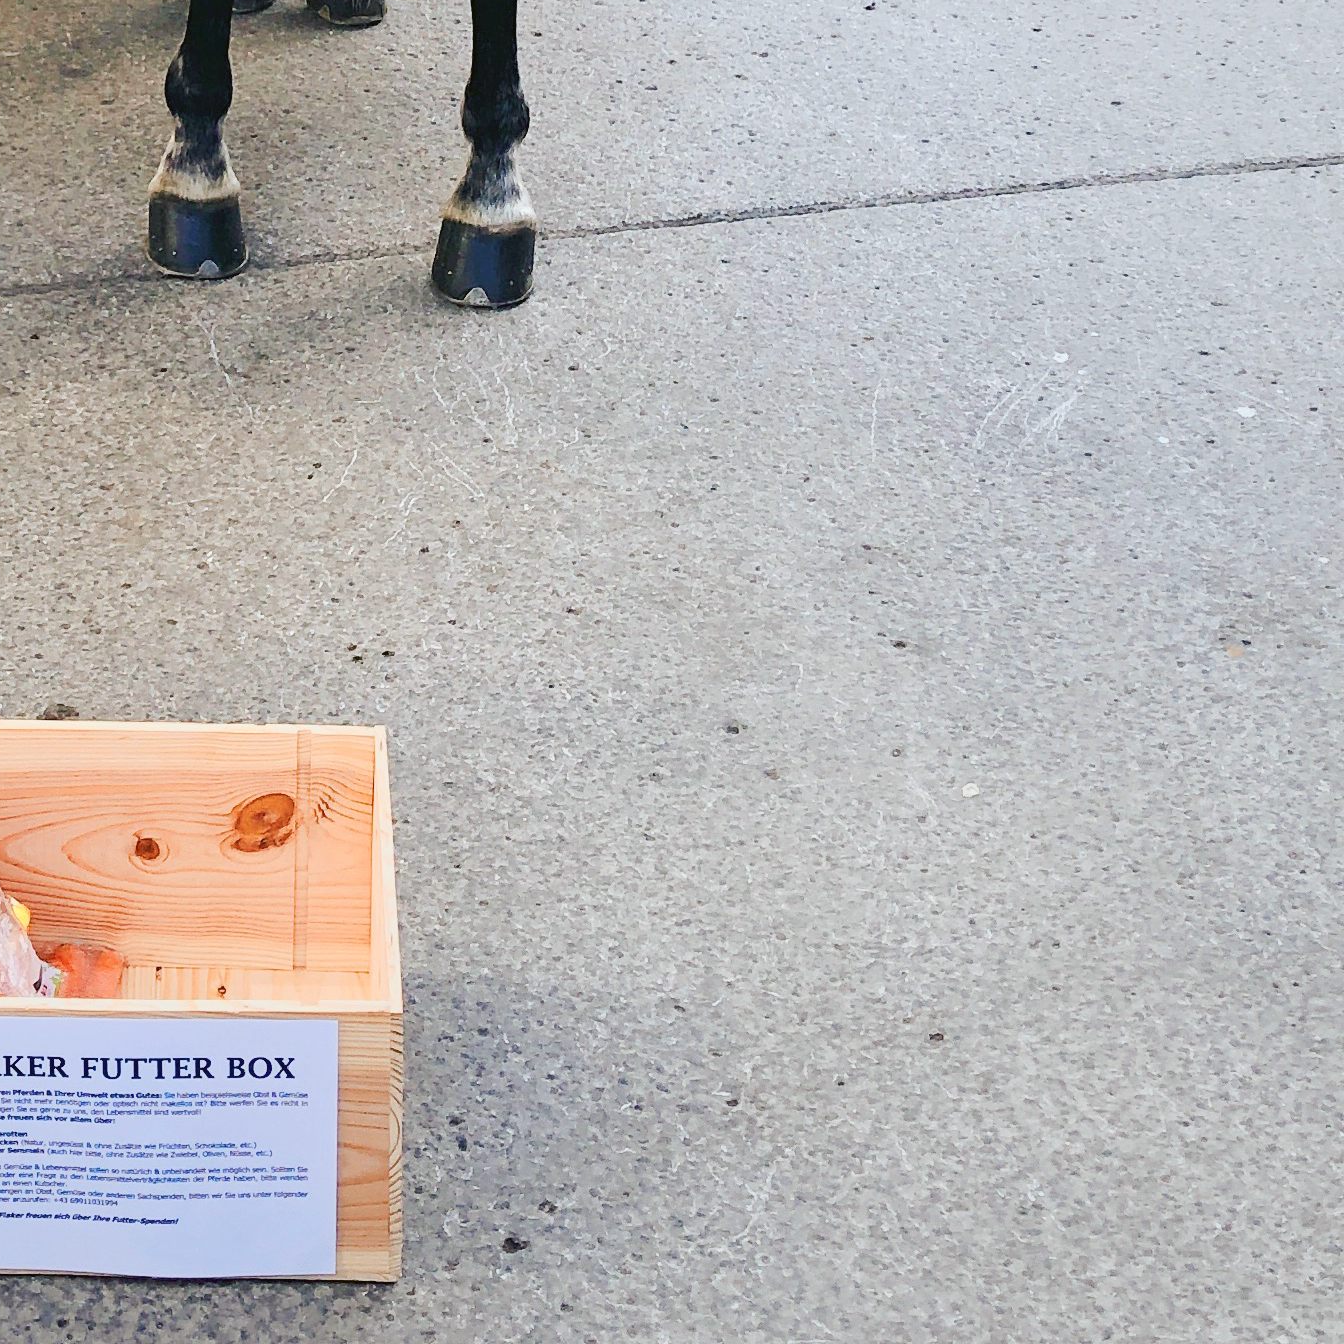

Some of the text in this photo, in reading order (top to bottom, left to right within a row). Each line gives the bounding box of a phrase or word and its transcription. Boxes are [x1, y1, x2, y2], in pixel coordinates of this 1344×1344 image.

[80, 1056, 215, 1080] FUTTER
[226, 1056, 296, 1079] BOX
[54, 1090, 76, 1098] Ihrer
[72, 1213, 91, 1221] über
[92, 1214, 111, 1222] Ihre
